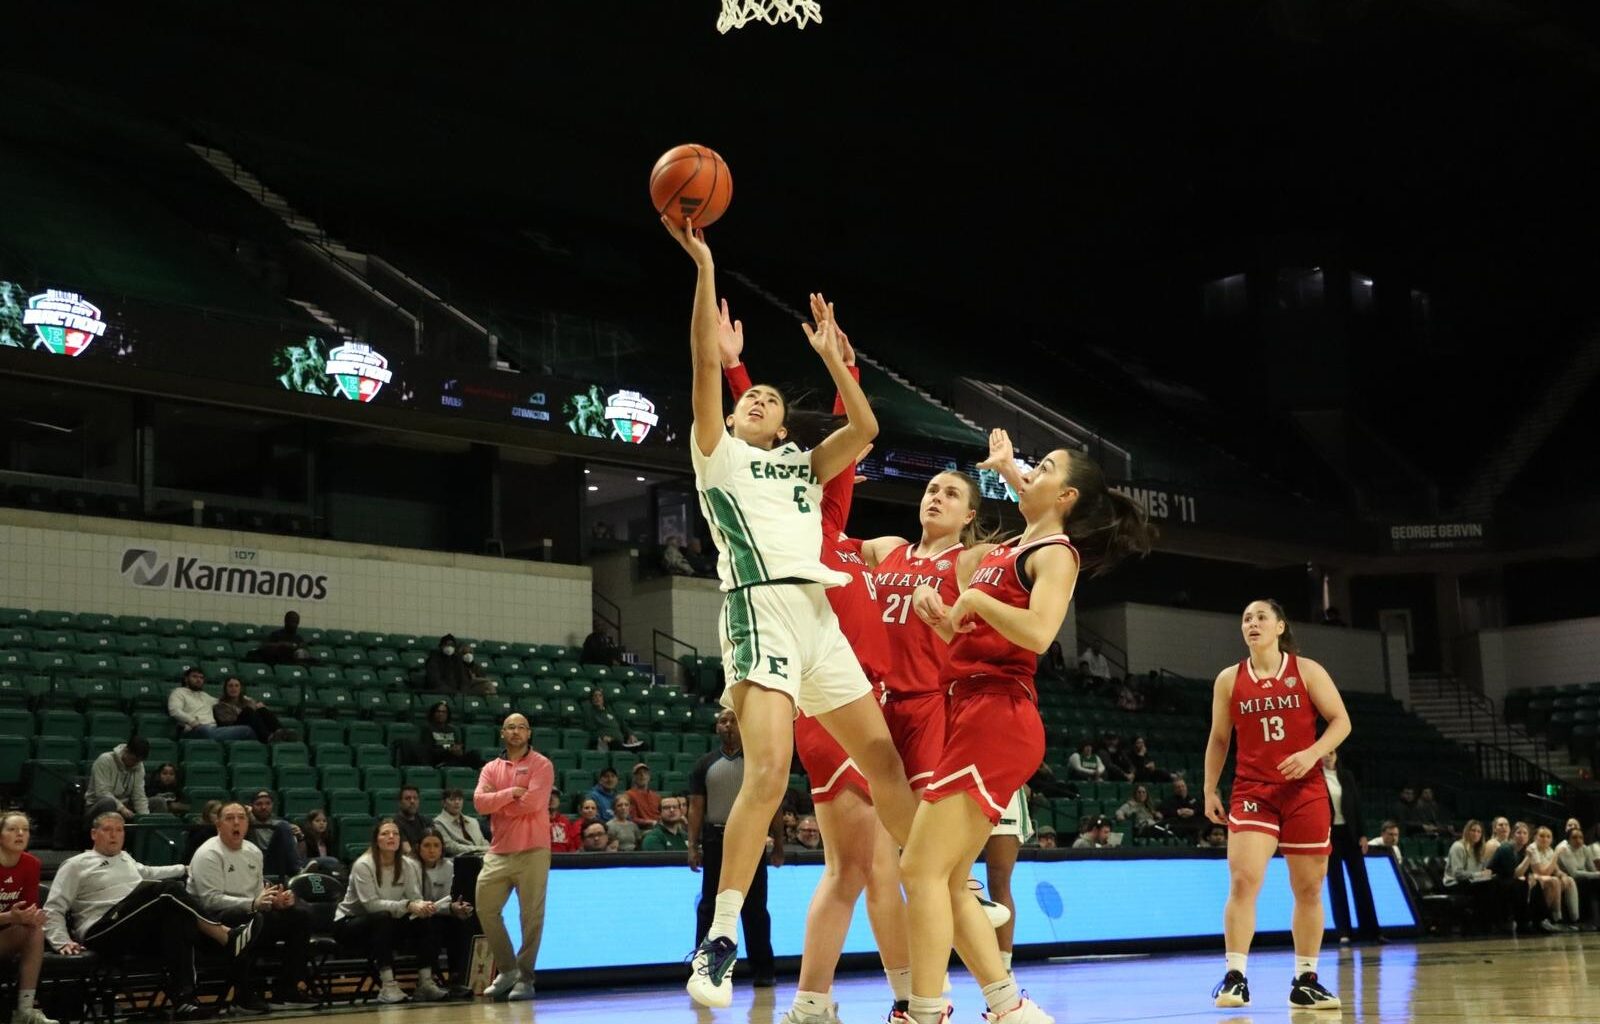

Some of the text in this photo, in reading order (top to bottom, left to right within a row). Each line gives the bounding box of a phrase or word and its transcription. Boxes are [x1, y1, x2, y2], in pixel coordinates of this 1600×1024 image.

[1174, 494, 1196, 523] '11
[1391, 523, 1481, 540] GEORGE GERVIN
[234, 551, 256, 561] 107
[173, 556, 328, 601] Karmanos
[875, 573, 943, 593] MIAMI
[882, 593, 912, 625] 21
[767, 654, 788, 679] E
[1240, 694, 1300, 714] MIAMI
[1260, 716, 1285, 742] 13
[1243, 800, 1258, 813] M
